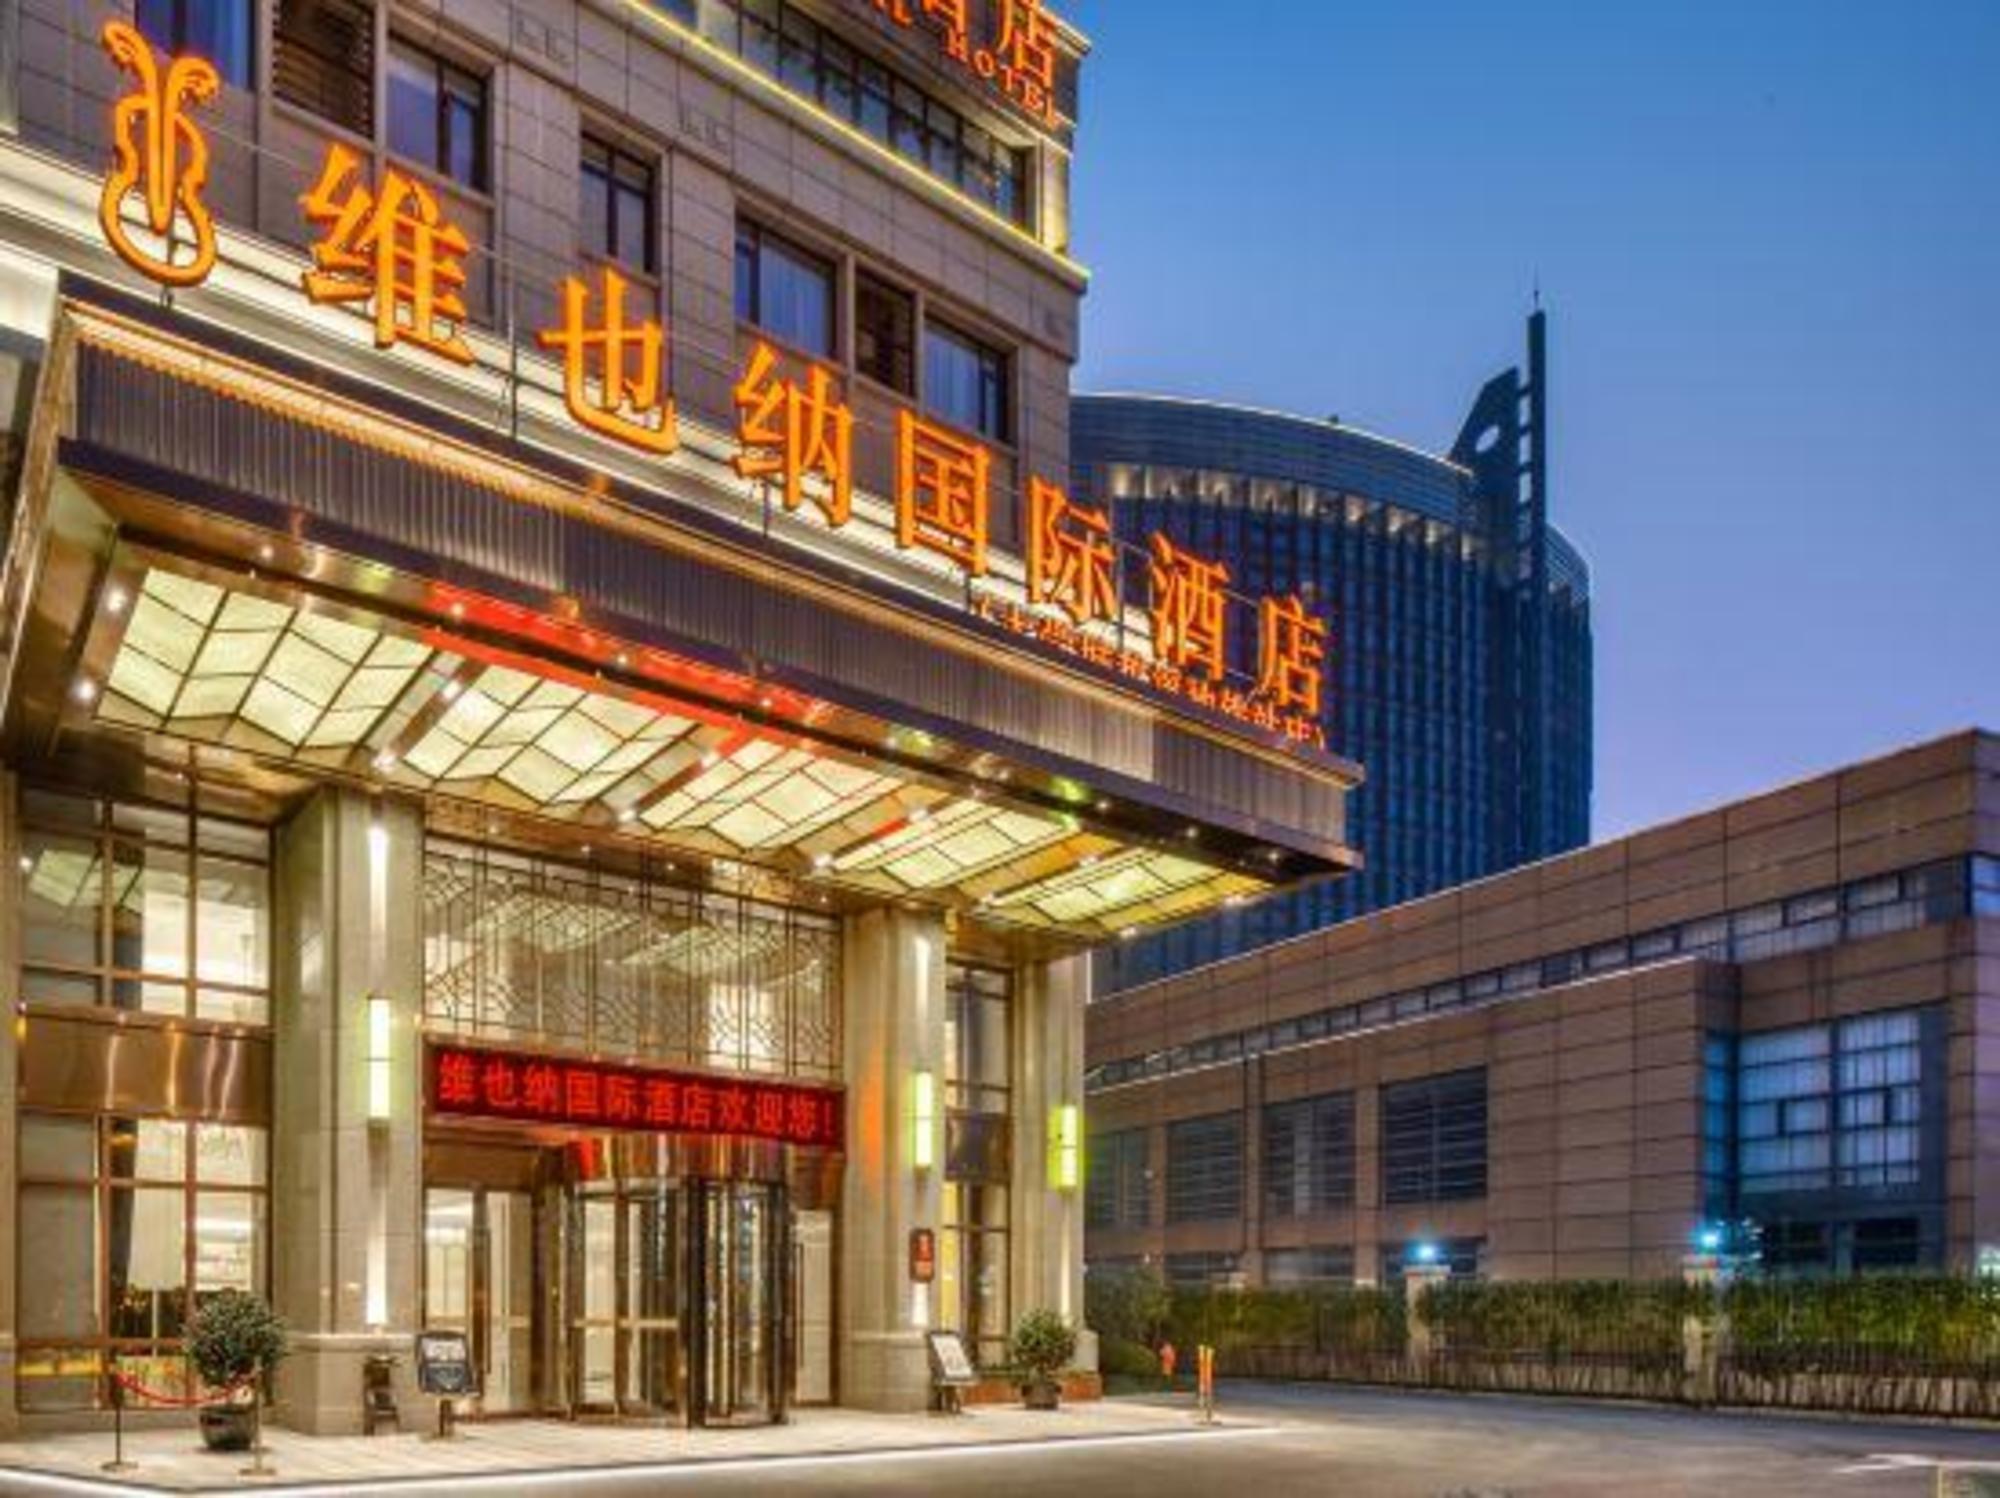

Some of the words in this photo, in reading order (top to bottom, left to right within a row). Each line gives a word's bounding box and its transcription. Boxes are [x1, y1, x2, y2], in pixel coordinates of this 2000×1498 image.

[946, 24, 1060, 130] HOTEL
[301, 143, 1329, 716] 维也纳国际酒店
